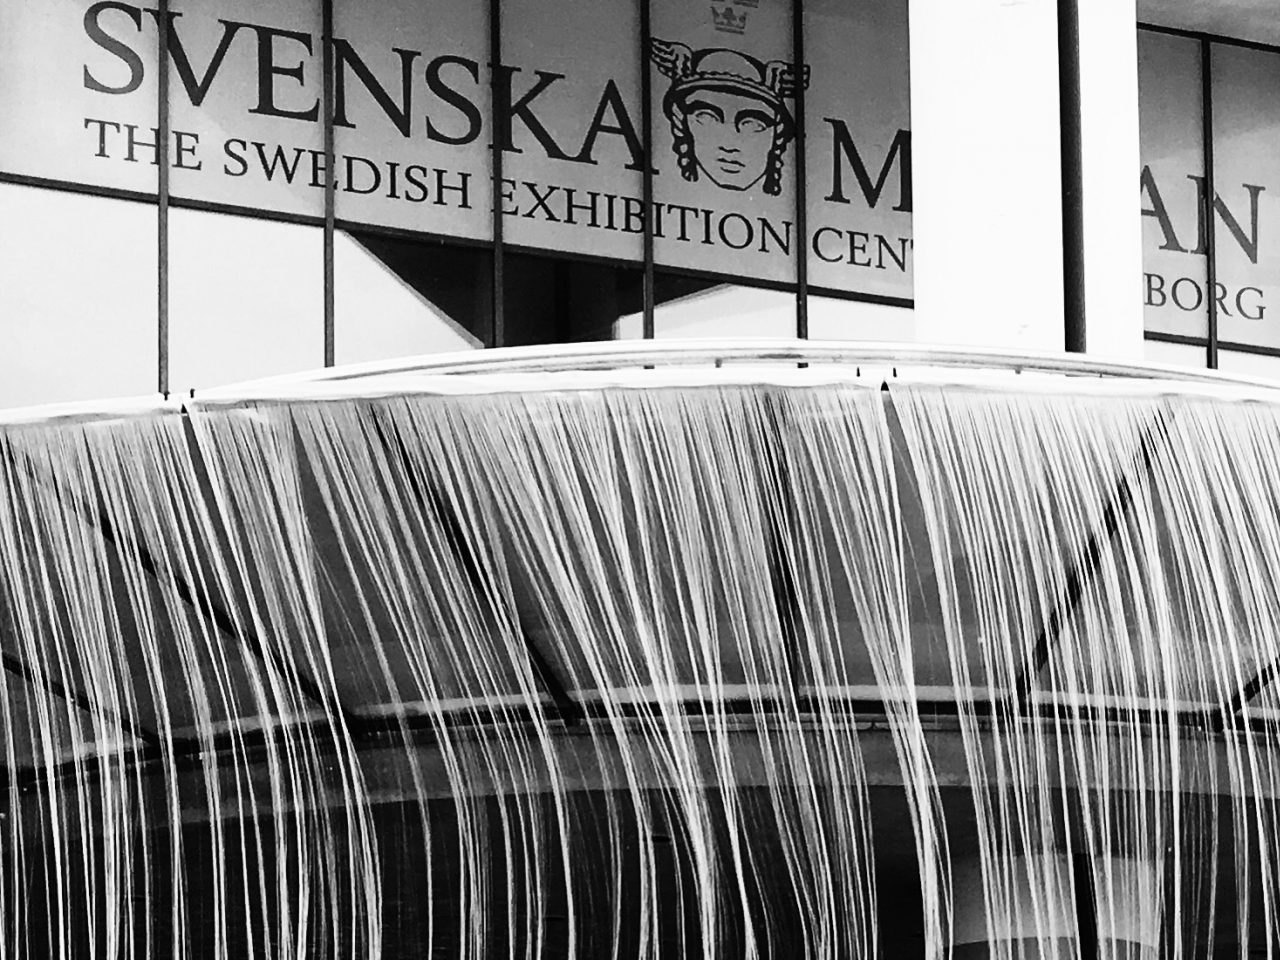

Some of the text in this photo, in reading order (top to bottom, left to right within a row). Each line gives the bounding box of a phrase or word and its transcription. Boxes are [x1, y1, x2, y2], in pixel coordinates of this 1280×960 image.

[83, 1, 660, 175] SVENSKA
[84, 117, 203, 171] THE
[223, 138, 472, 210] SWEDISH
[491, 178, 792, 257] EXHIBITION
[812, 226, 913, 275] CEN
